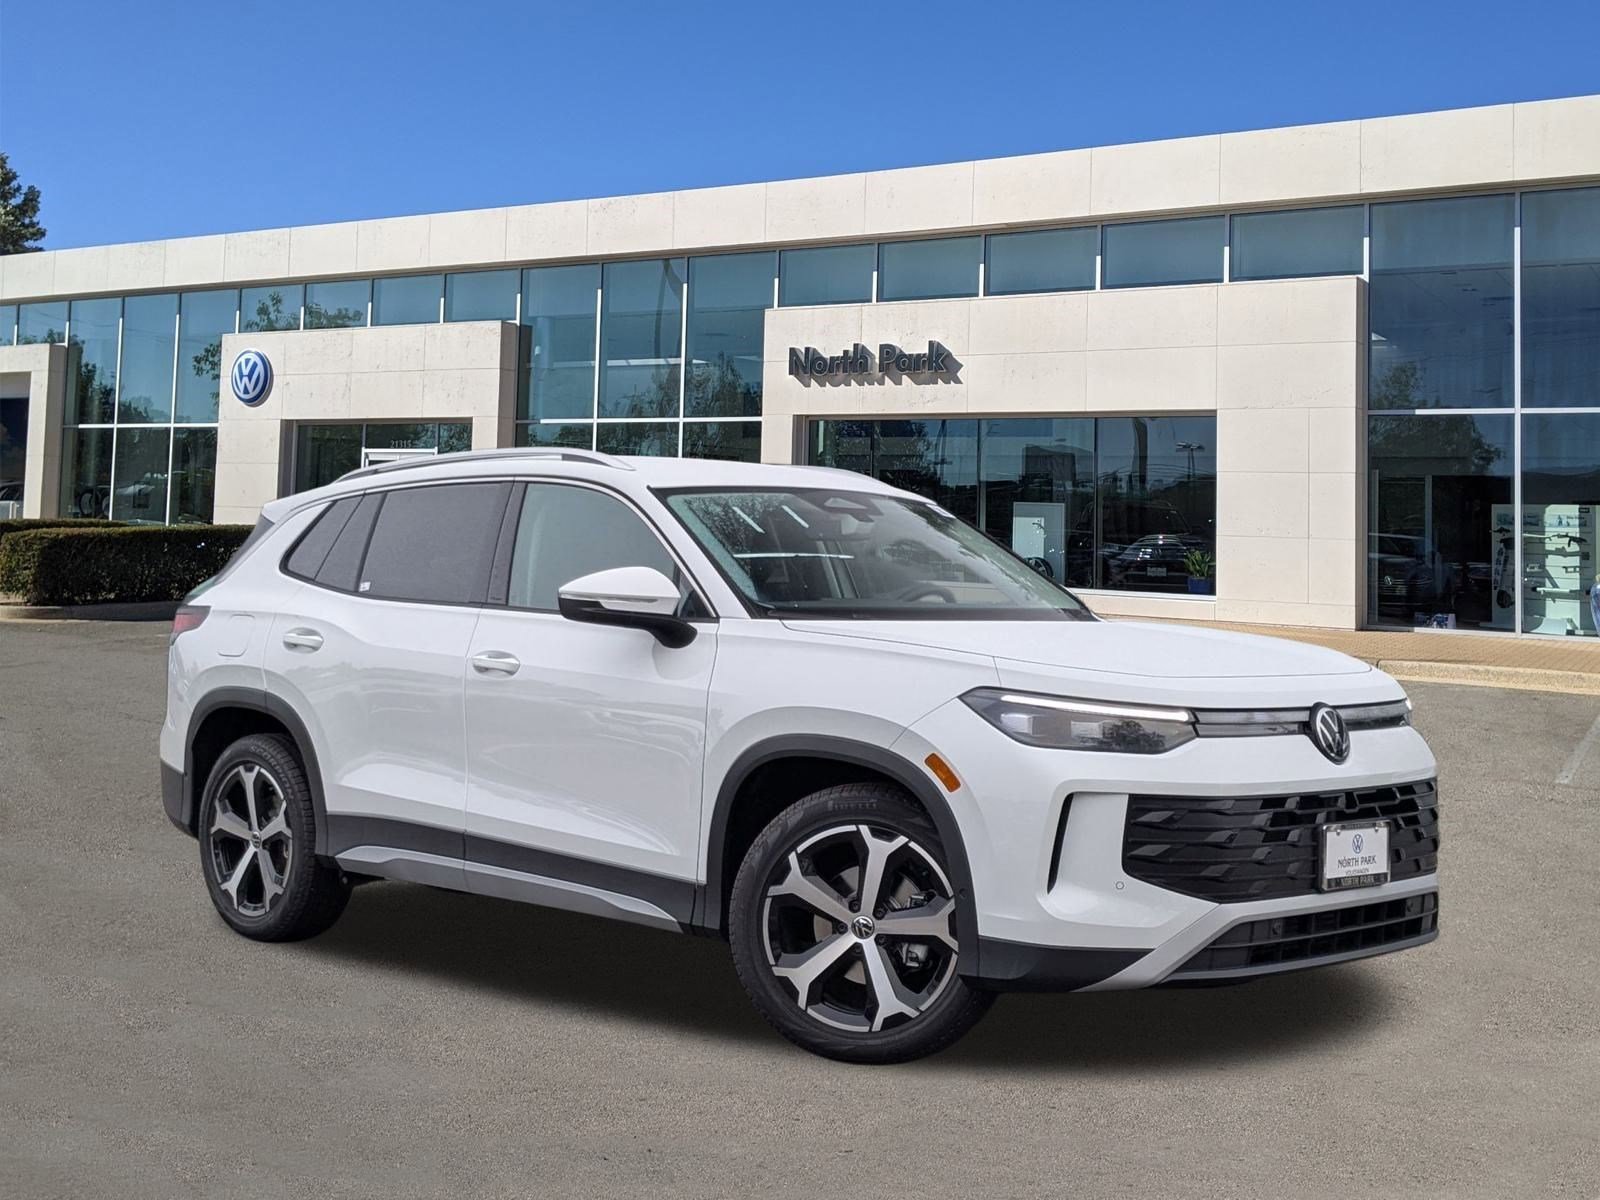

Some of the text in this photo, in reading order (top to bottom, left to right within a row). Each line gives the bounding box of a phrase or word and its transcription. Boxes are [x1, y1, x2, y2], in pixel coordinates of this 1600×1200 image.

[788, 340, 948, 377] North Park
[1338, 855, 1376, 868] NORTH PARK
